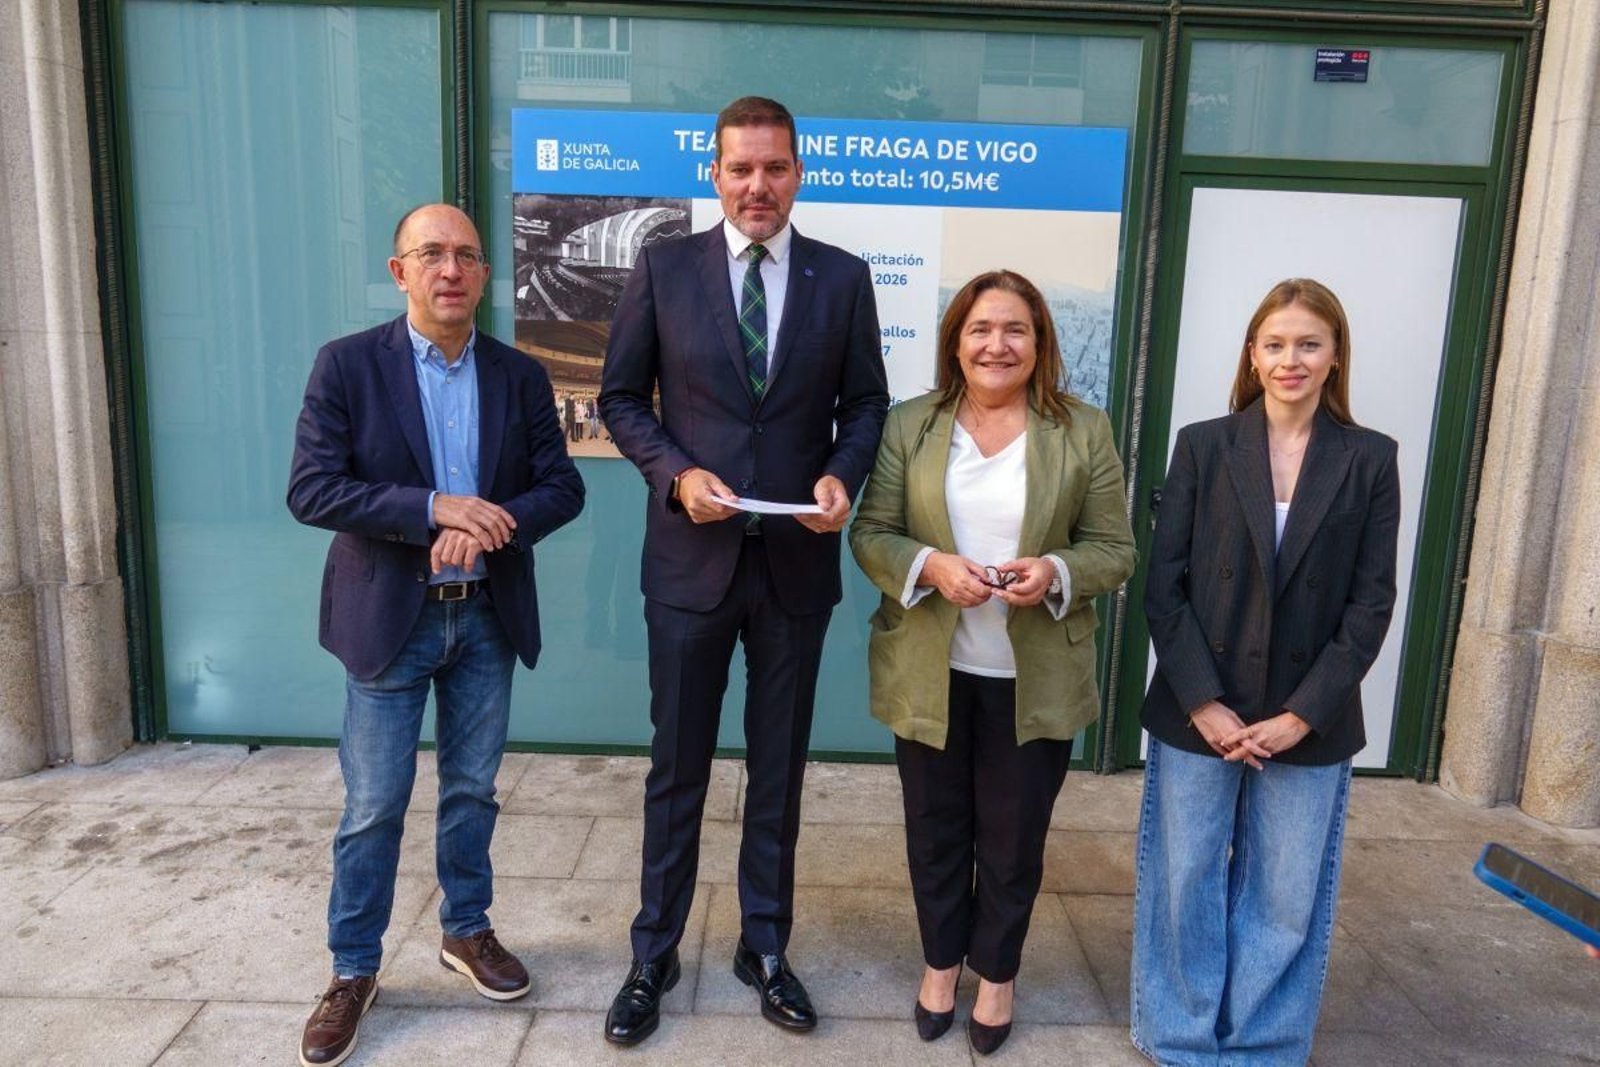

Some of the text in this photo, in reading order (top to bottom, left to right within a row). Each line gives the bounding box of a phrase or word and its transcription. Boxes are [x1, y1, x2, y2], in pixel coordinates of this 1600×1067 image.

[563, 142, 611, 156] XUNTA
[673, 130, 1037, 163] TEA INE FRAGA DE VIGO
[563, 157, 640, 171] DE GALICIA
[850, 169, 914, 189] total:
[919, 170, 1000, 193] 10,5M€
[875, 272, 908, 286] 2026
[880, 325, 917, 339] allos
[882, 344, 891, 357] 7
